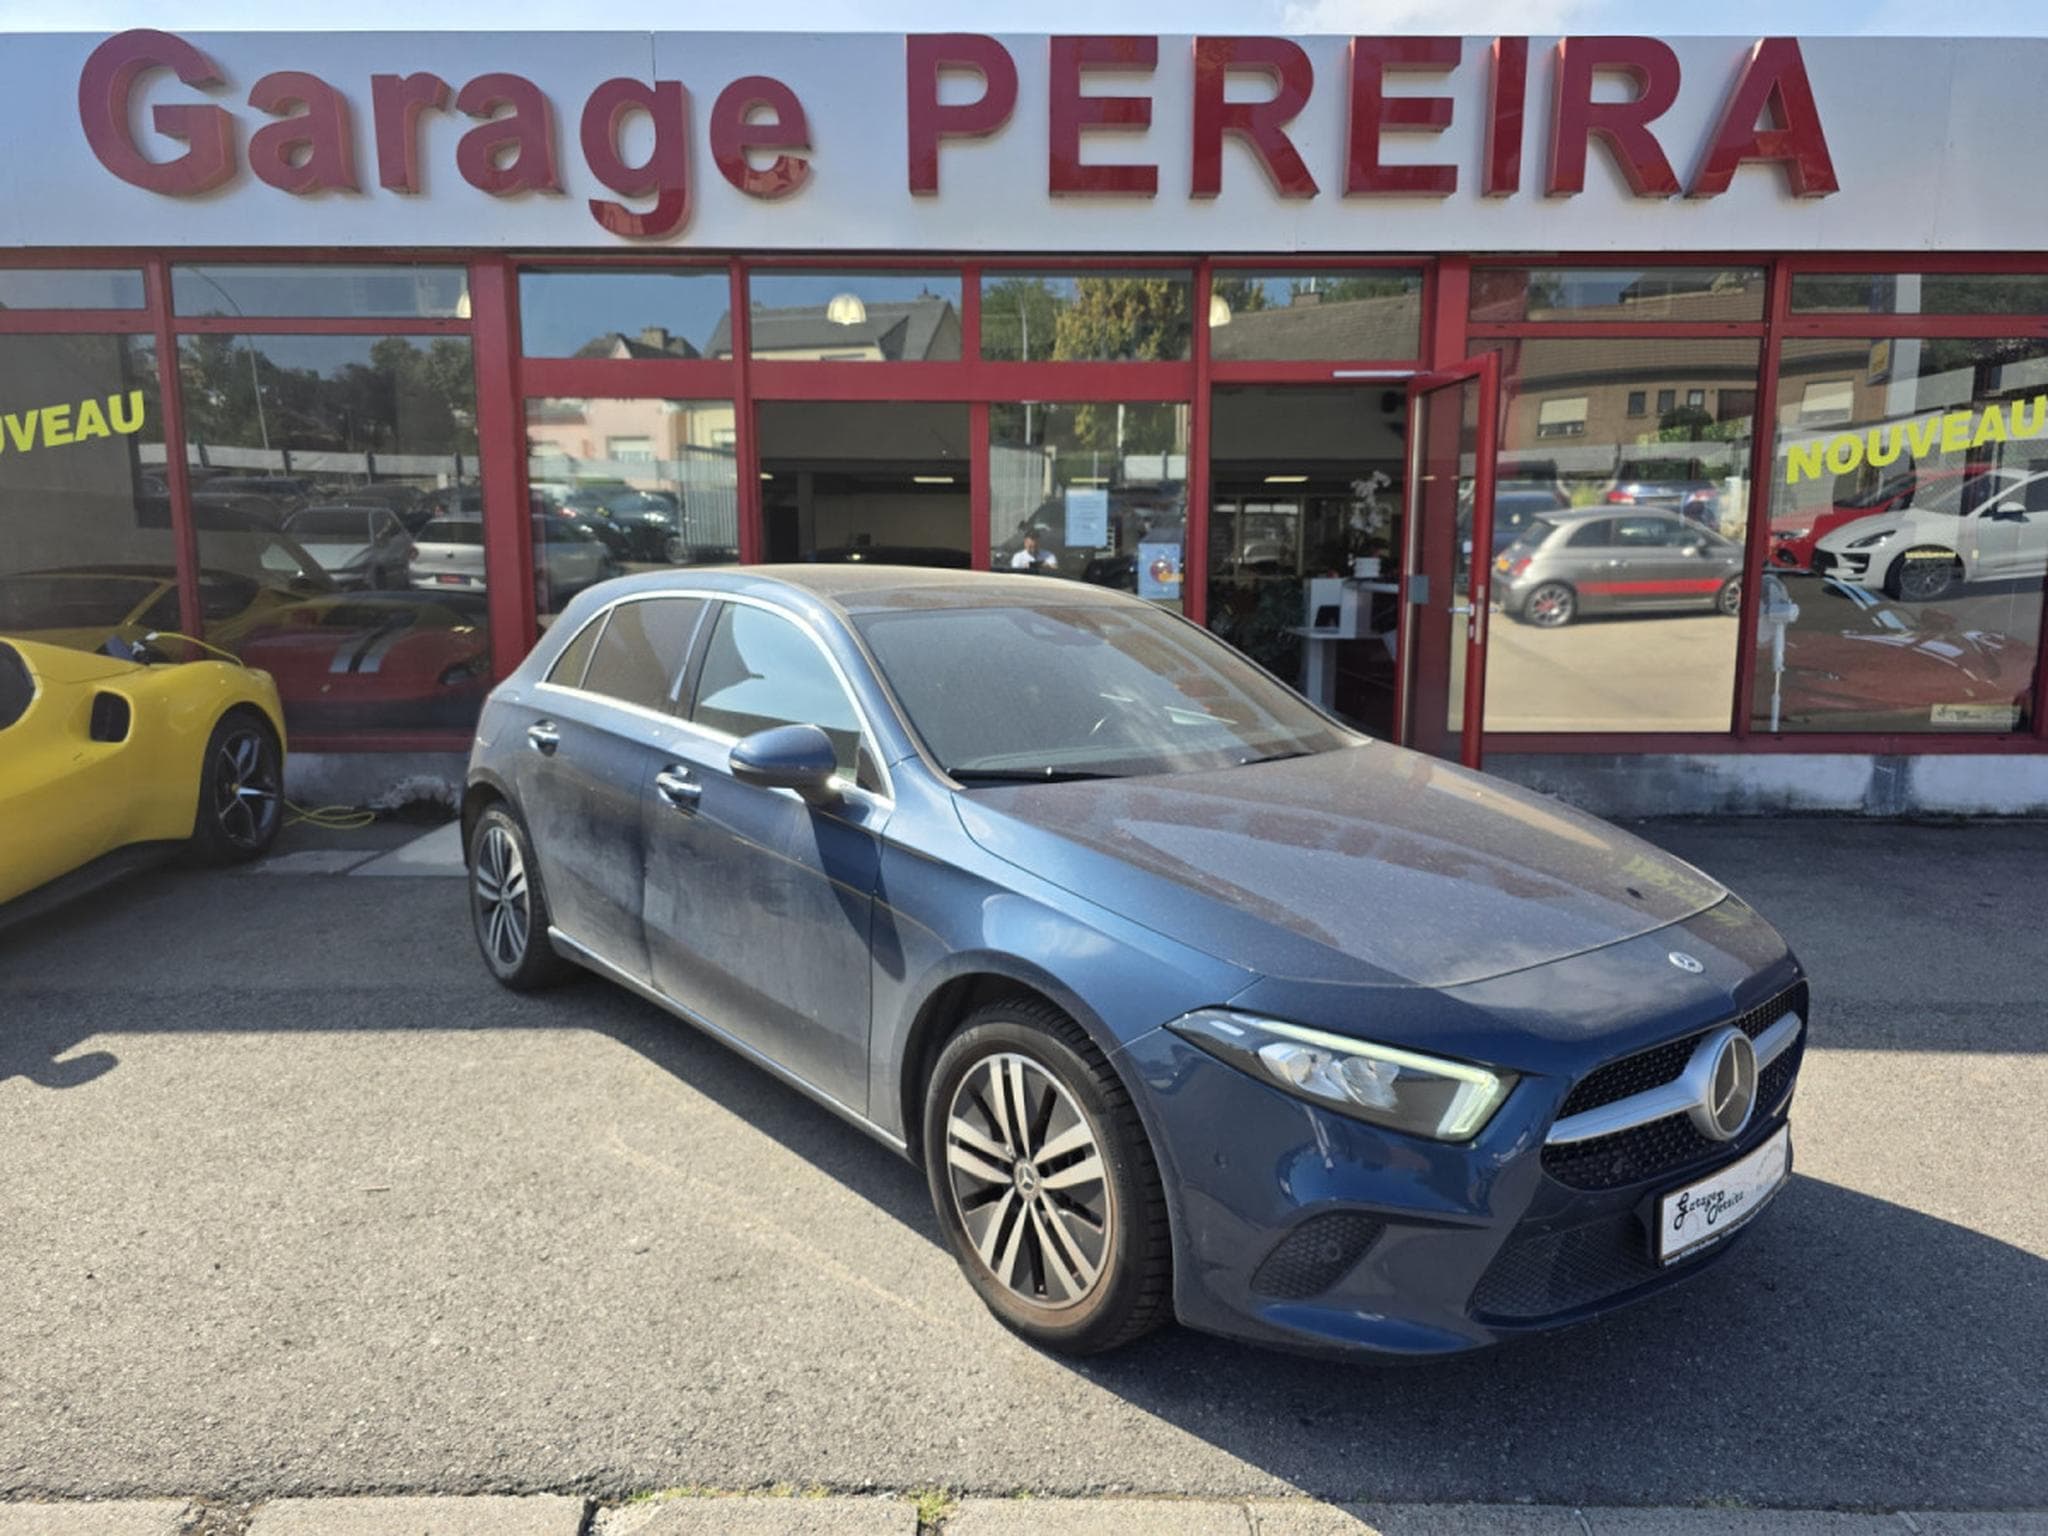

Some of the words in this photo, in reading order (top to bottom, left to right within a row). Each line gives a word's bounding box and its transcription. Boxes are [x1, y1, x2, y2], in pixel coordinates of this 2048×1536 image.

[78, 28, 815, 240] Garage
[906, 34, 1840, 198] PEREIRA
[0, 390, 145, 453] VEAU
[1786, 394, 2047, 485] NOUVEAU
